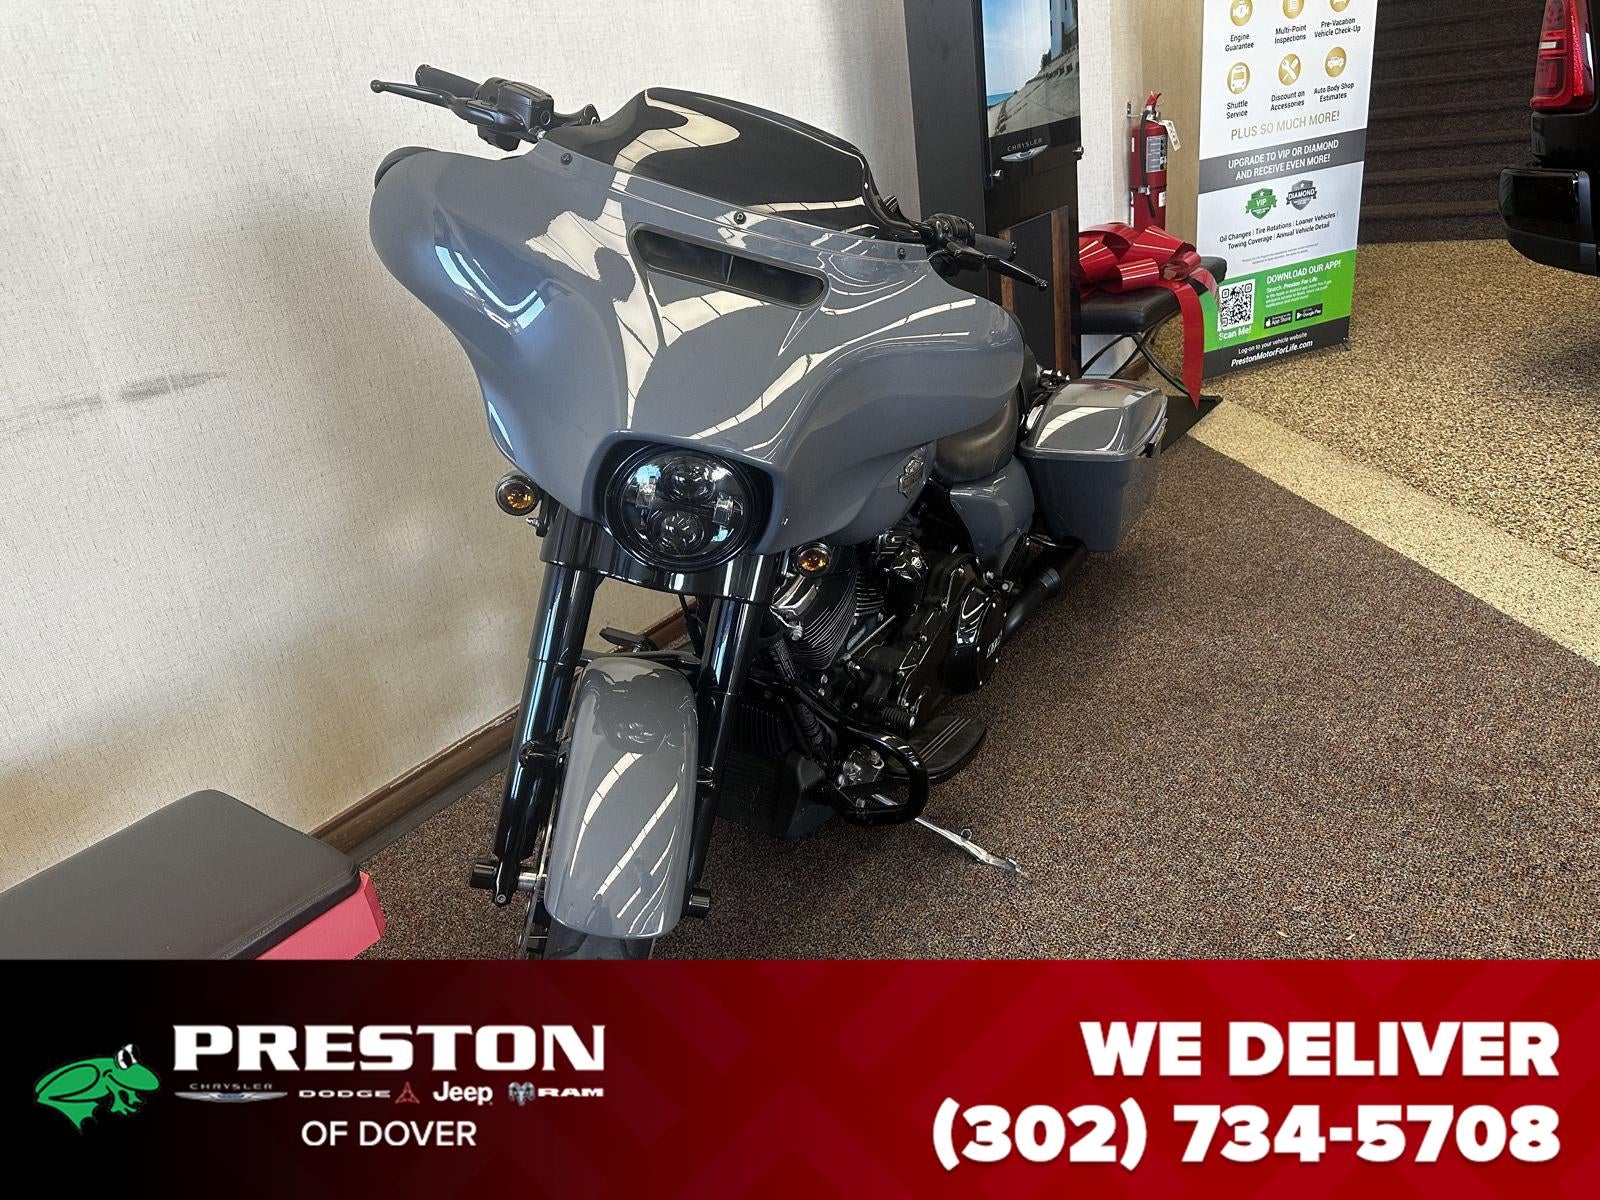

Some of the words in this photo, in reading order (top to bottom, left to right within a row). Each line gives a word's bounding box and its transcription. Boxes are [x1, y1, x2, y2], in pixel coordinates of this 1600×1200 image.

[1321, 17, 1355, 28] Pre-Vacation
[1276, 25, 1306, 34] Multi-Point
[1314, 28, 1333, 38] Vehicle
[1335, 25, 1361, 36] Check-Up
[1230, 33, 1250, 42] Engine
[1275, 34, 1306, 45] Inspections
[1225, 42, 1254, 51] Guarantee
[1314, 86, 1326, 94] Auto
[1327, 84, 1340, 93] Body
[1341, 82, 1354, 91] Shop
[1271, 92, 1296, 102] Discount
[1320, 92, 1347, 102] Estimates
[1227, 100, 1248, 109] Shuttle
[1271, 101, 1304, 111] Accessories
[1227, 110, 1248, 119] Service
[1231, 125, 1257, 140] PLUS
[1260, 124, 1274, 135] SO
[1277, 119, 1306, 131] MUCH
[1309, 111, 1340, 125] MORE!
[1007, 138, 1042, 151] CHRYSLER
[1228, 155, 1265, 169] UPGRADE
[1266, 153, 1276, 161] TO
[1278, 149, 1291, 159] VIP
[1292, 147, 1303, 156] OR
[1304, 140, 1338, 154] DIAMOND
[1236, 169, 1252, 180] AND
[1254, 164, 1285, 177] RECEIVE
[1286, 161, 1307, 170] EVEN
[1307, 154, 1331, 167] MORE!
[1288, 188, 1315, 200] DIAMOND
[1256, 198, 1266, 207] VIP
[1219, 234, 1227, 243] Oil
[1228, 230, 1252, 242] Changes
[1256, 226, 1265, 235] Tire
[1266, 221, 1292, 233] Rotations
[1295, 217, 1313, 227] Loaner
[1314, 212, 1336, 222] Vehicles
[1228, 240, 1247, 250] Towing
[1248, 236, 1272, 247] Coverage
[1276, 230, 1294, 239] Annual
[1295, 226, 1314, 235] Vehicle
[1314, 221, 1330, 231] Detail
[1266, 268, 1307, 284] DOWNLOAD
[1309, 263, 1324, 274] OUR
[1324, 259, 1341, 271] APP!
[1283, 281, 1301, 289] Preston
[1219, 329, 1236, 341] Scan
[1237, 325, 1252, 336] Me!
[1238, 344, 1254, 354] Log-on
[1261, 341, 1272, 350] your
[1273, 337, 1290, 345] vehicle
[1290, 332, 1308, 342] website
[1231, 340, 1313, 367] PrestonMotorForLife.com
